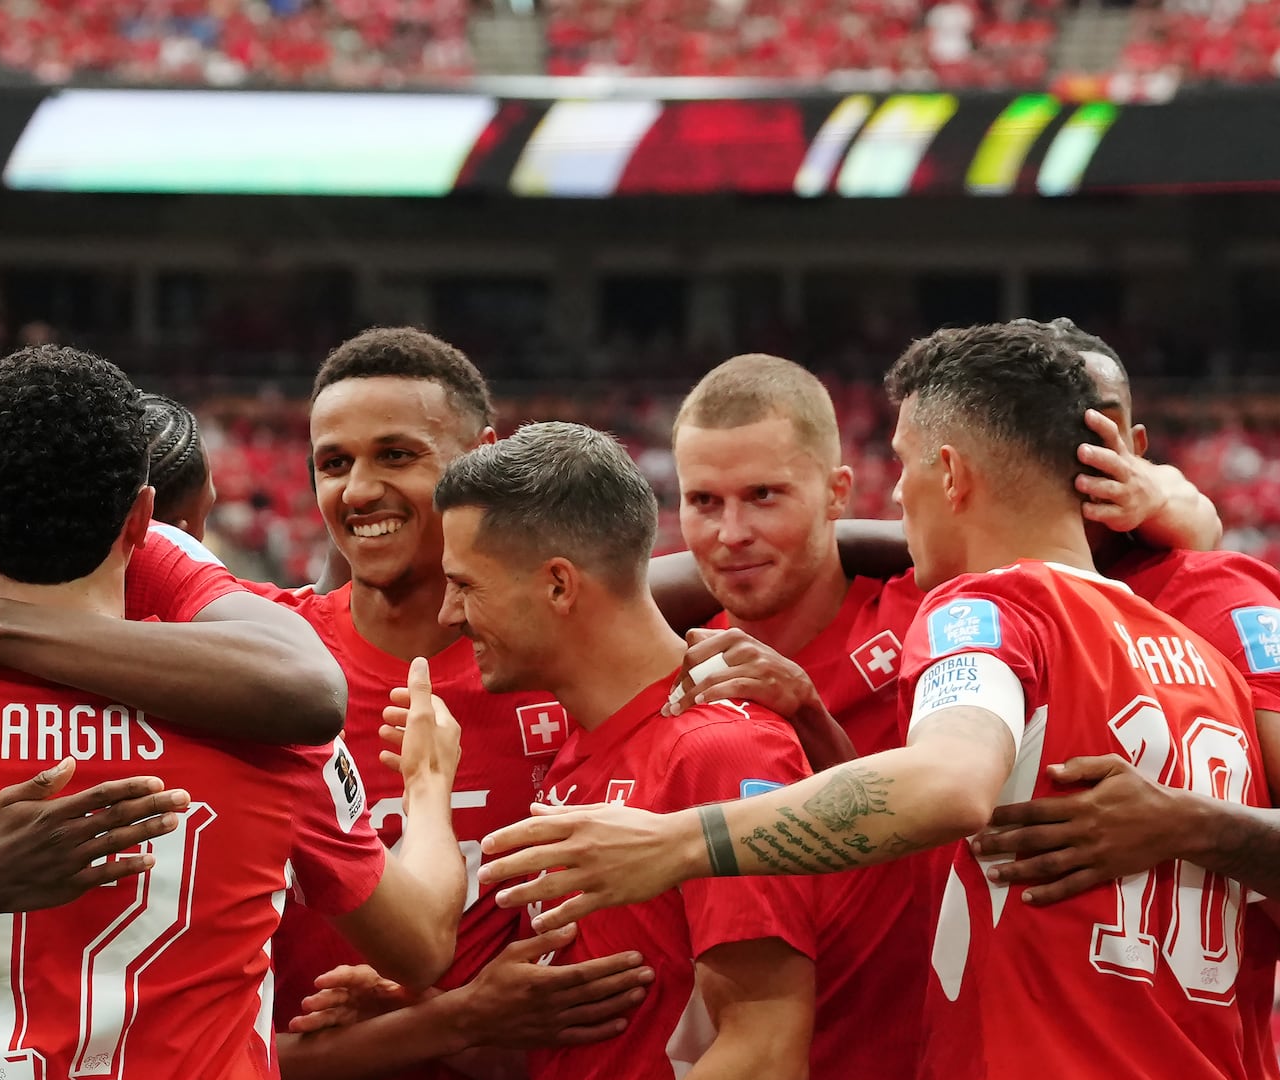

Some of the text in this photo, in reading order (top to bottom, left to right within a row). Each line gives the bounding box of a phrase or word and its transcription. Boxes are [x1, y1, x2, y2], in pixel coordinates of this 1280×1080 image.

[923, 657, 977, 683] FOOTBALL
[923, 668, 977, 697] UNITES
[1089, 694, 1252, 1007] 10
